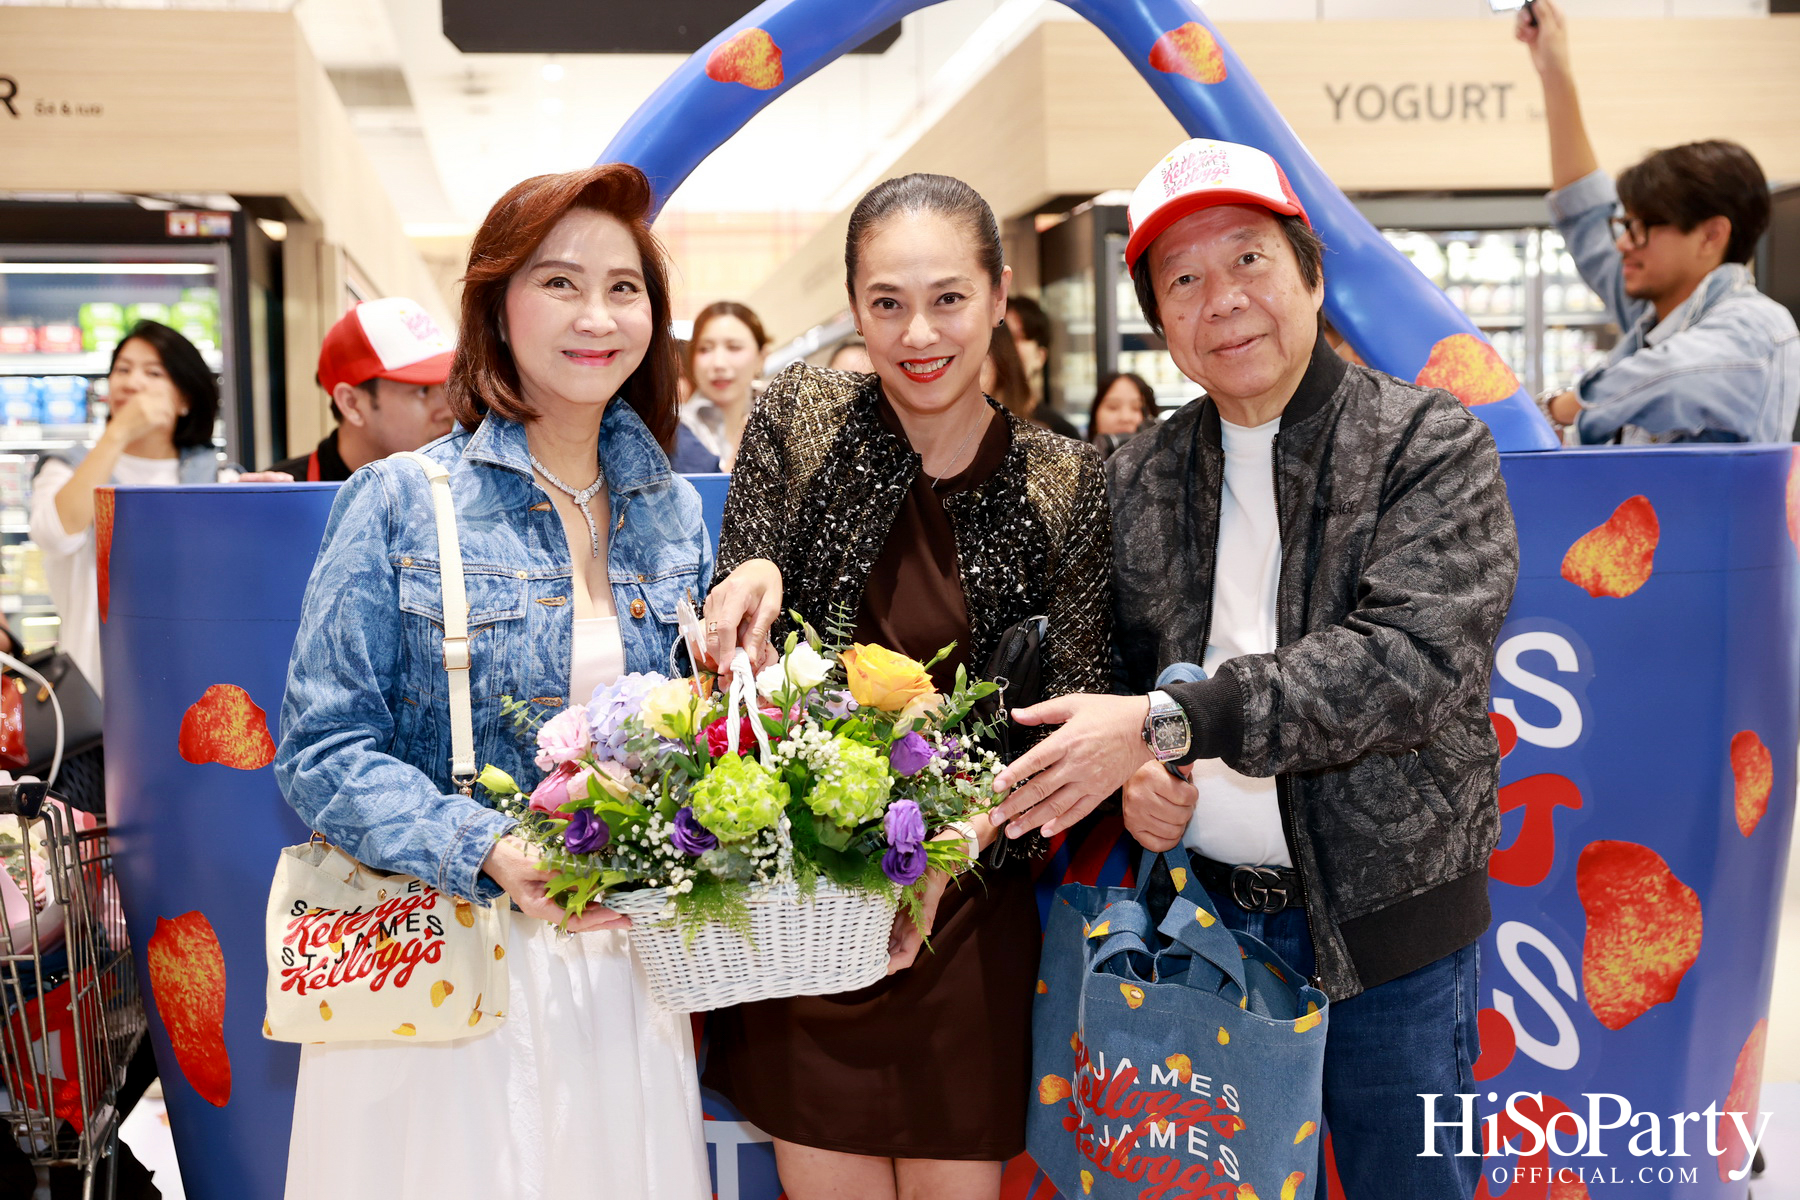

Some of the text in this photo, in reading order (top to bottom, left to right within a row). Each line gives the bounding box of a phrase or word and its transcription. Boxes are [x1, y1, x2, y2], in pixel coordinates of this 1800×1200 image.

[1324, 83, 1514, 121] YOGURT
[280, 929, 446, 996] Kellogg's
[334, 912, 445, 964] JAMES
[1093, 1051, 1240, 1113] JAMES
[1098, 1122, 1240, 1181] JAMES
